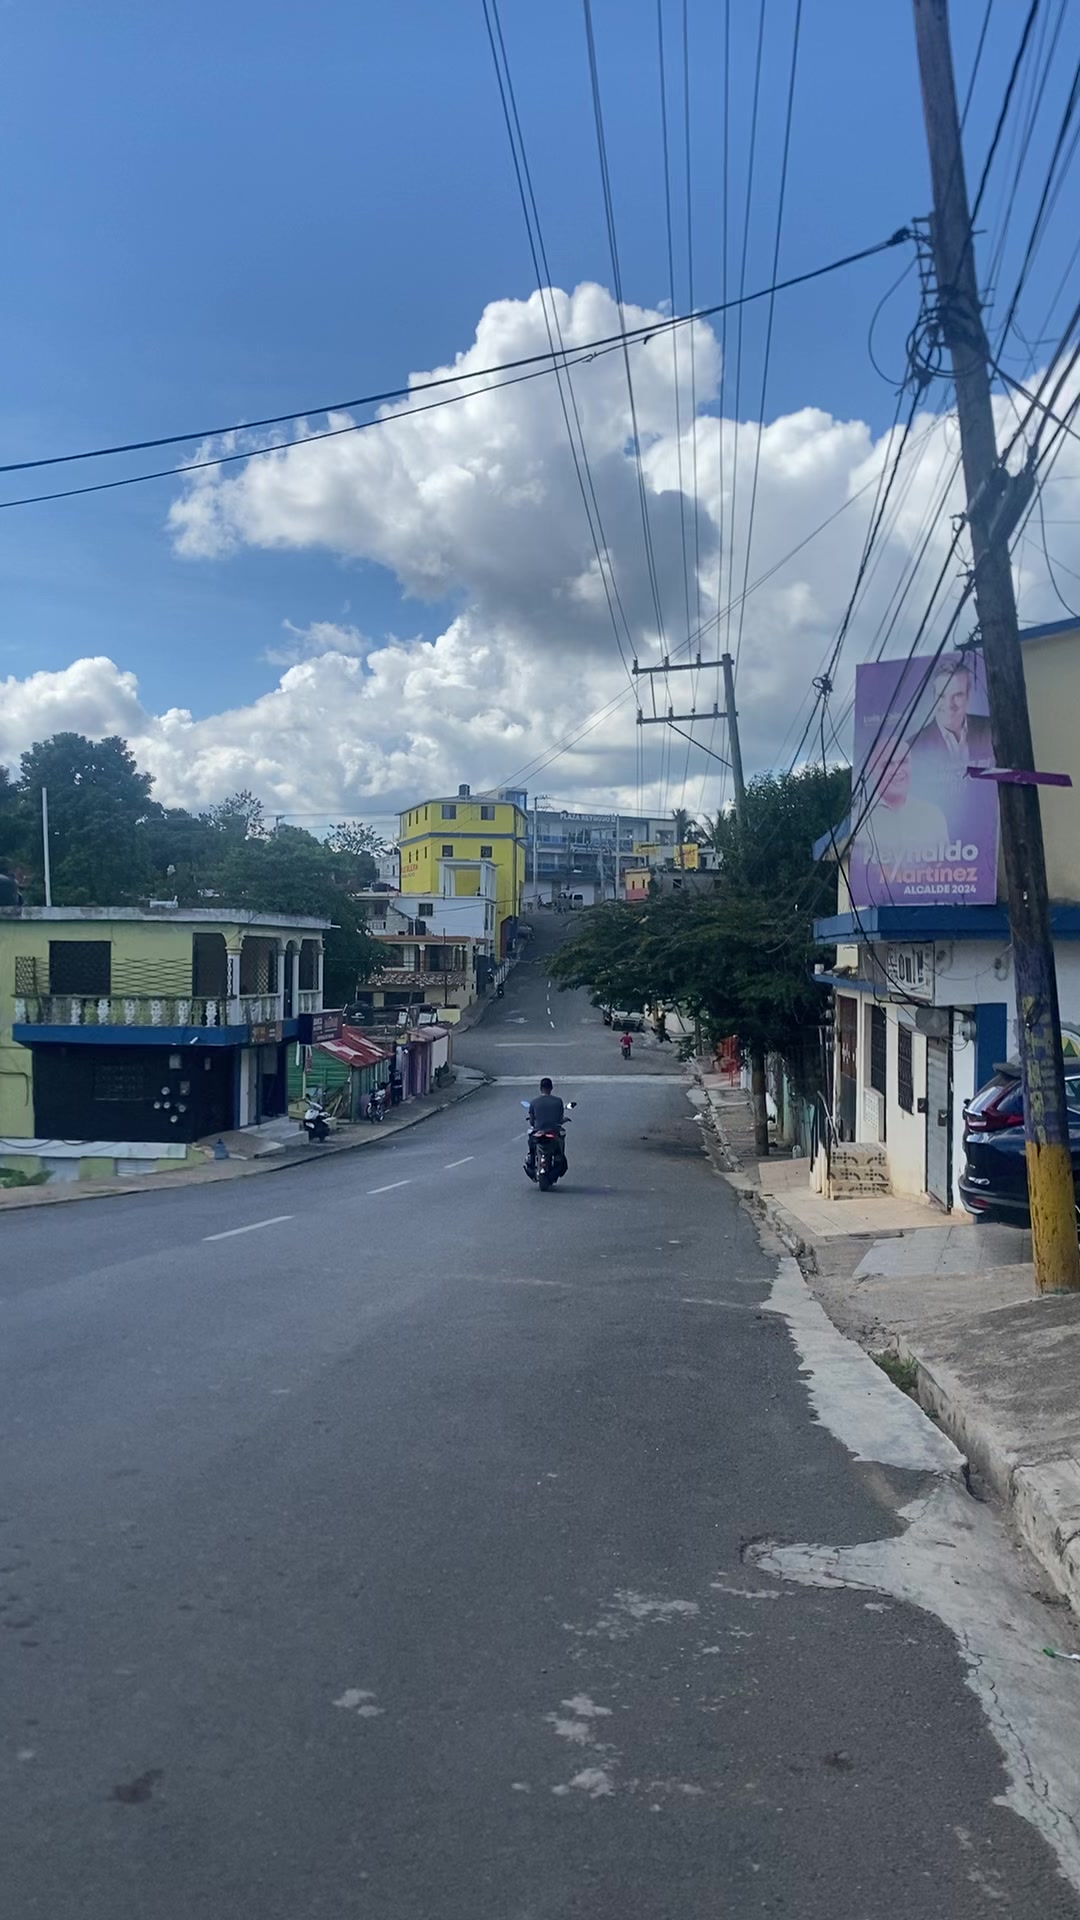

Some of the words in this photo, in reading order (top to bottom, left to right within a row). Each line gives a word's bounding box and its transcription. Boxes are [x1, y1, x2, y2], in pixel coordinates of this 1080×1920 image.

[560, 813, 580, 821] PLAZA
[864, 840, 978, 879] Reynaldo
[879, 864, 977, 883] Martínez
[903, 884, 950, 894] ALCALDE
[952, 884, 977, 893] 2024
